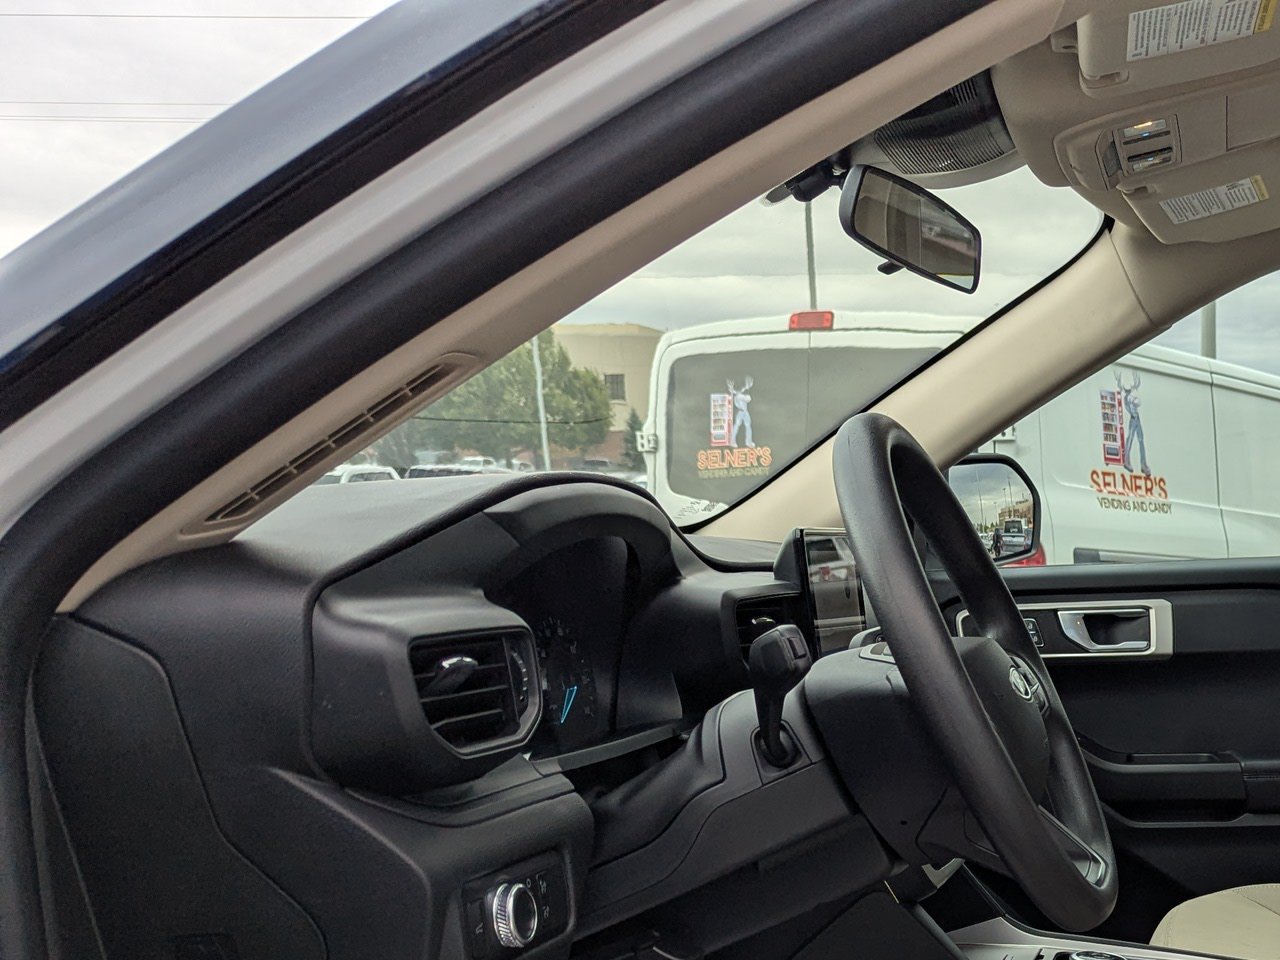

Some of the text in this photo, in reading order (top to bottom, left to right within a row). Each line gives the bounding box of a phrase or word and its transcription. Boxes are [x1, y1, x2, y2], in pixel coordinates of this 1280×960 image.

[697, 446, 772, 470] SELNER'S
[1091, 469, 1168, 500] SELNER'S
[1097, 497, 1173, 514] VENDING AND CANDY
